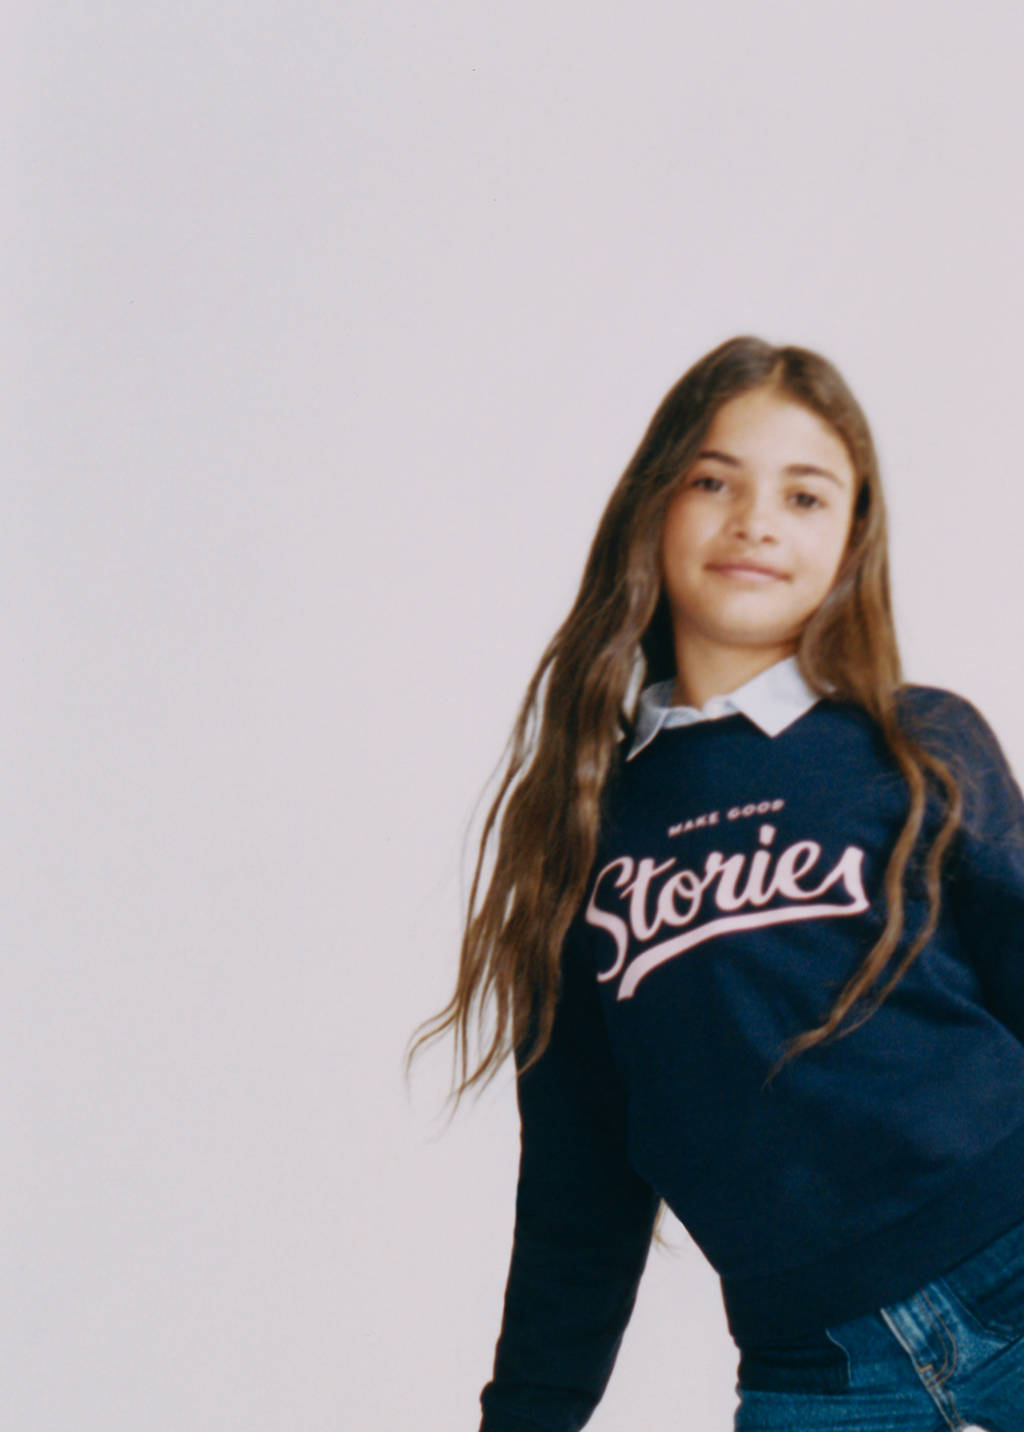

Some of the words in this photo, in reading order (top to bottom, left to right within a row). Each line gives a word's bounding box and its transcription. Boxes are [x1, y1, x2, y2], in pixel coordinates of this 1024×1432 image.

[668, 811, 719, 837] MAKE
[727, 799, 784, 820] GOOD
[586, 824, 869, 1000] Stories
